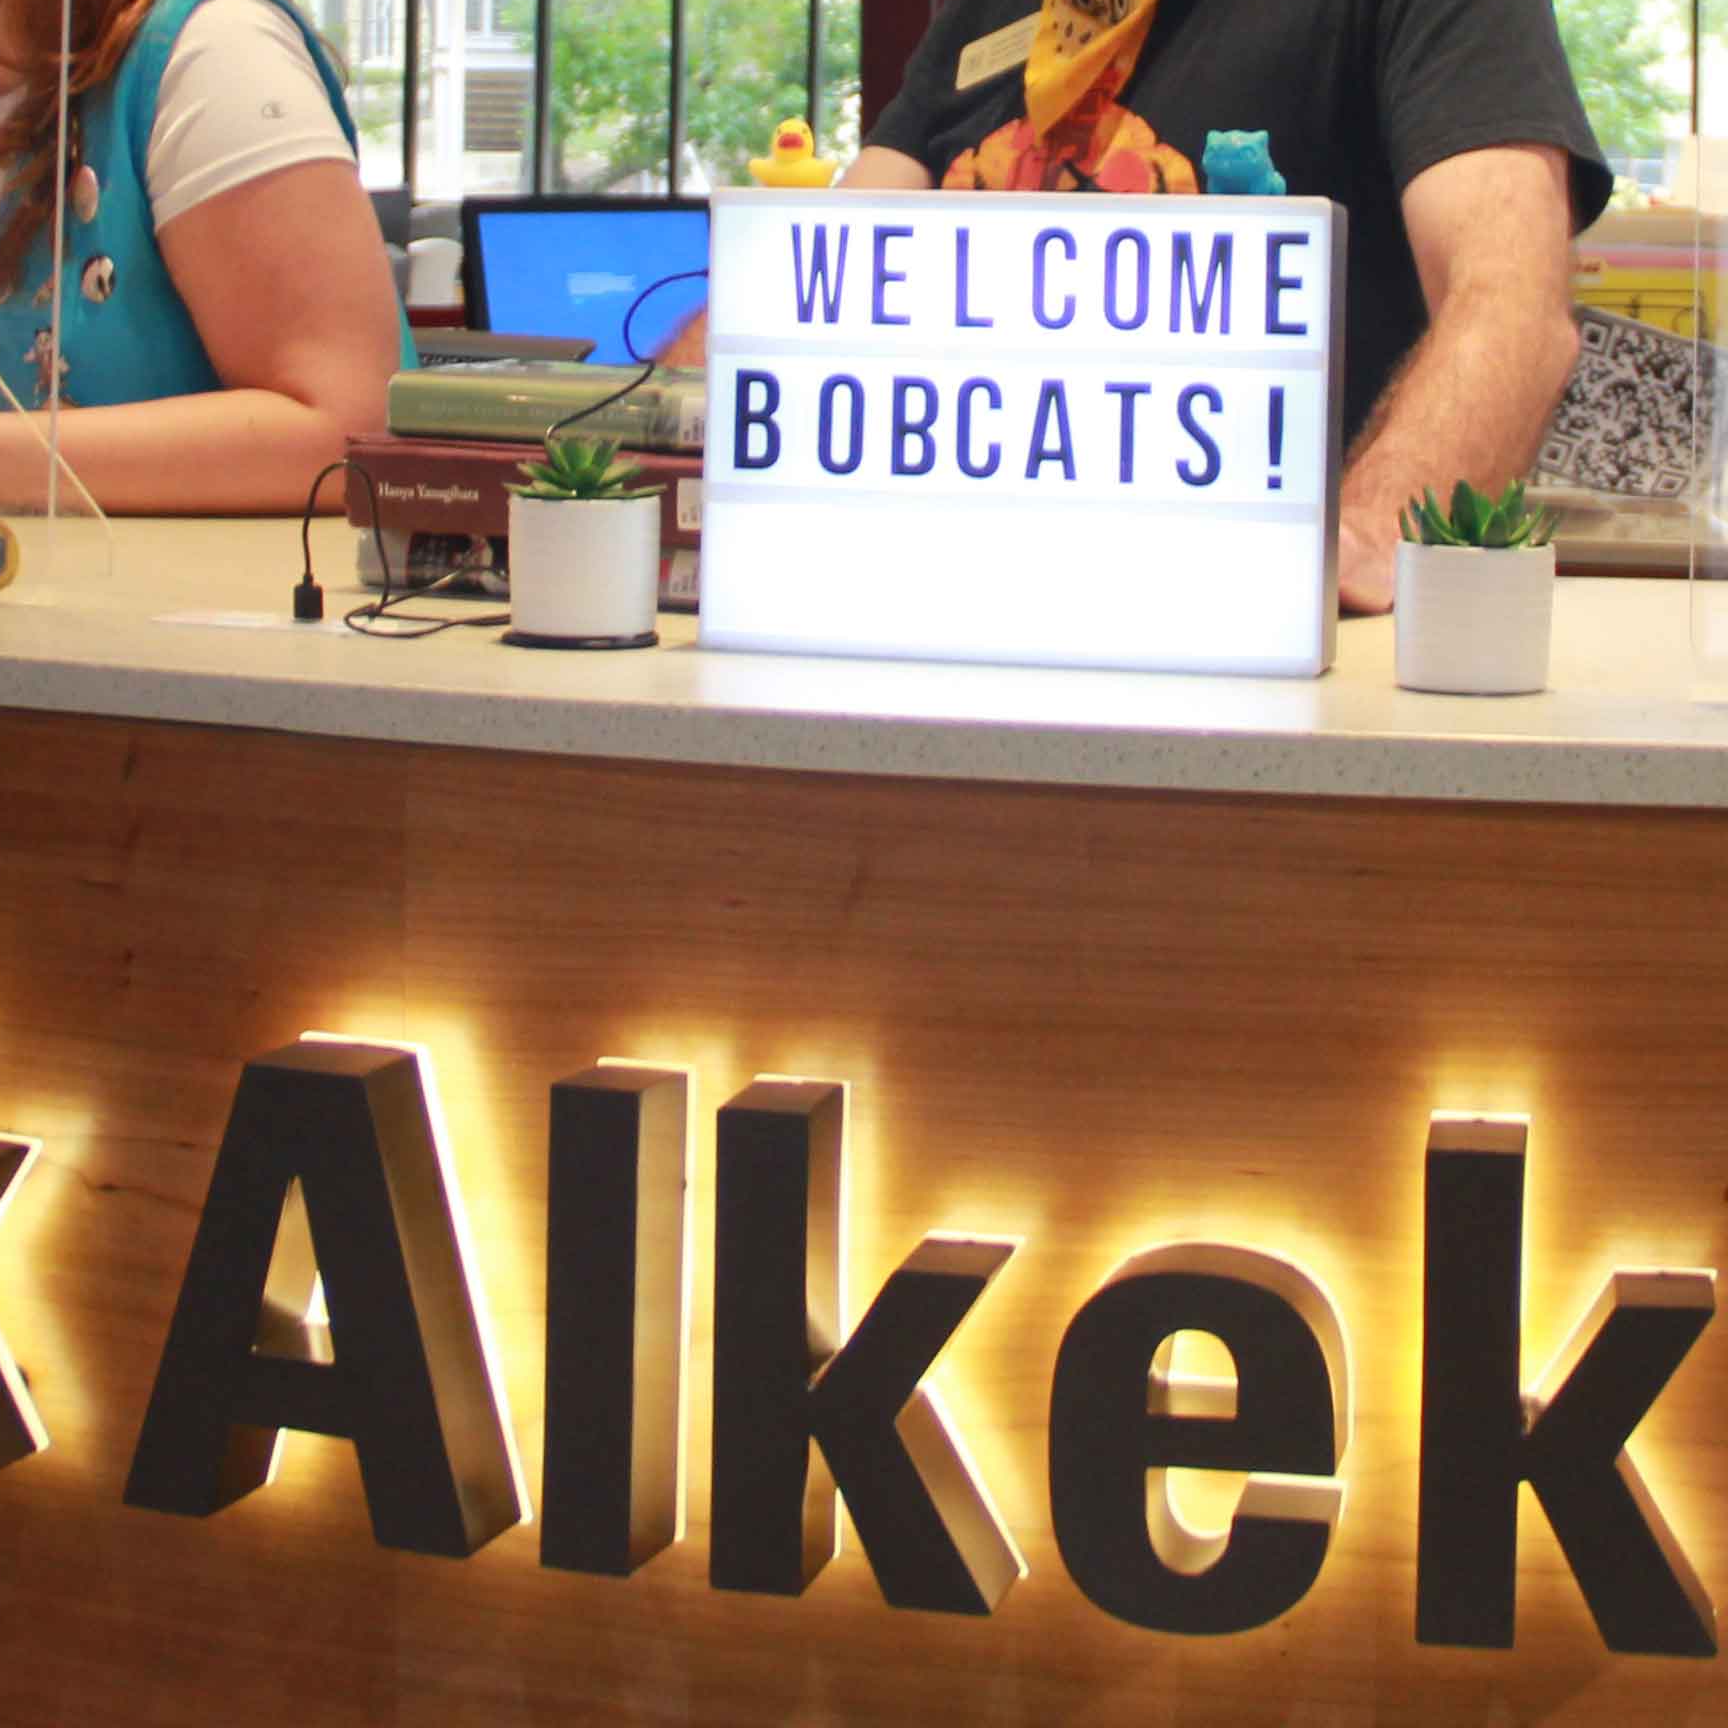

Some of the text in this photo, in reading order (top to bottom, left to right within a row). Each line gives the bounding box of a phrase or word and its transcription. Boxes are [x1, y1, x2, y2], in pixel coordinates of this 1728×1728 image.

[790, 222, 1311, 336] WELCOME
[732, 367, 1286, 491] BOBCATS!
[378, 480, 415, 501] Hanya
[122, 1030, 1719, 1658] Alkek
